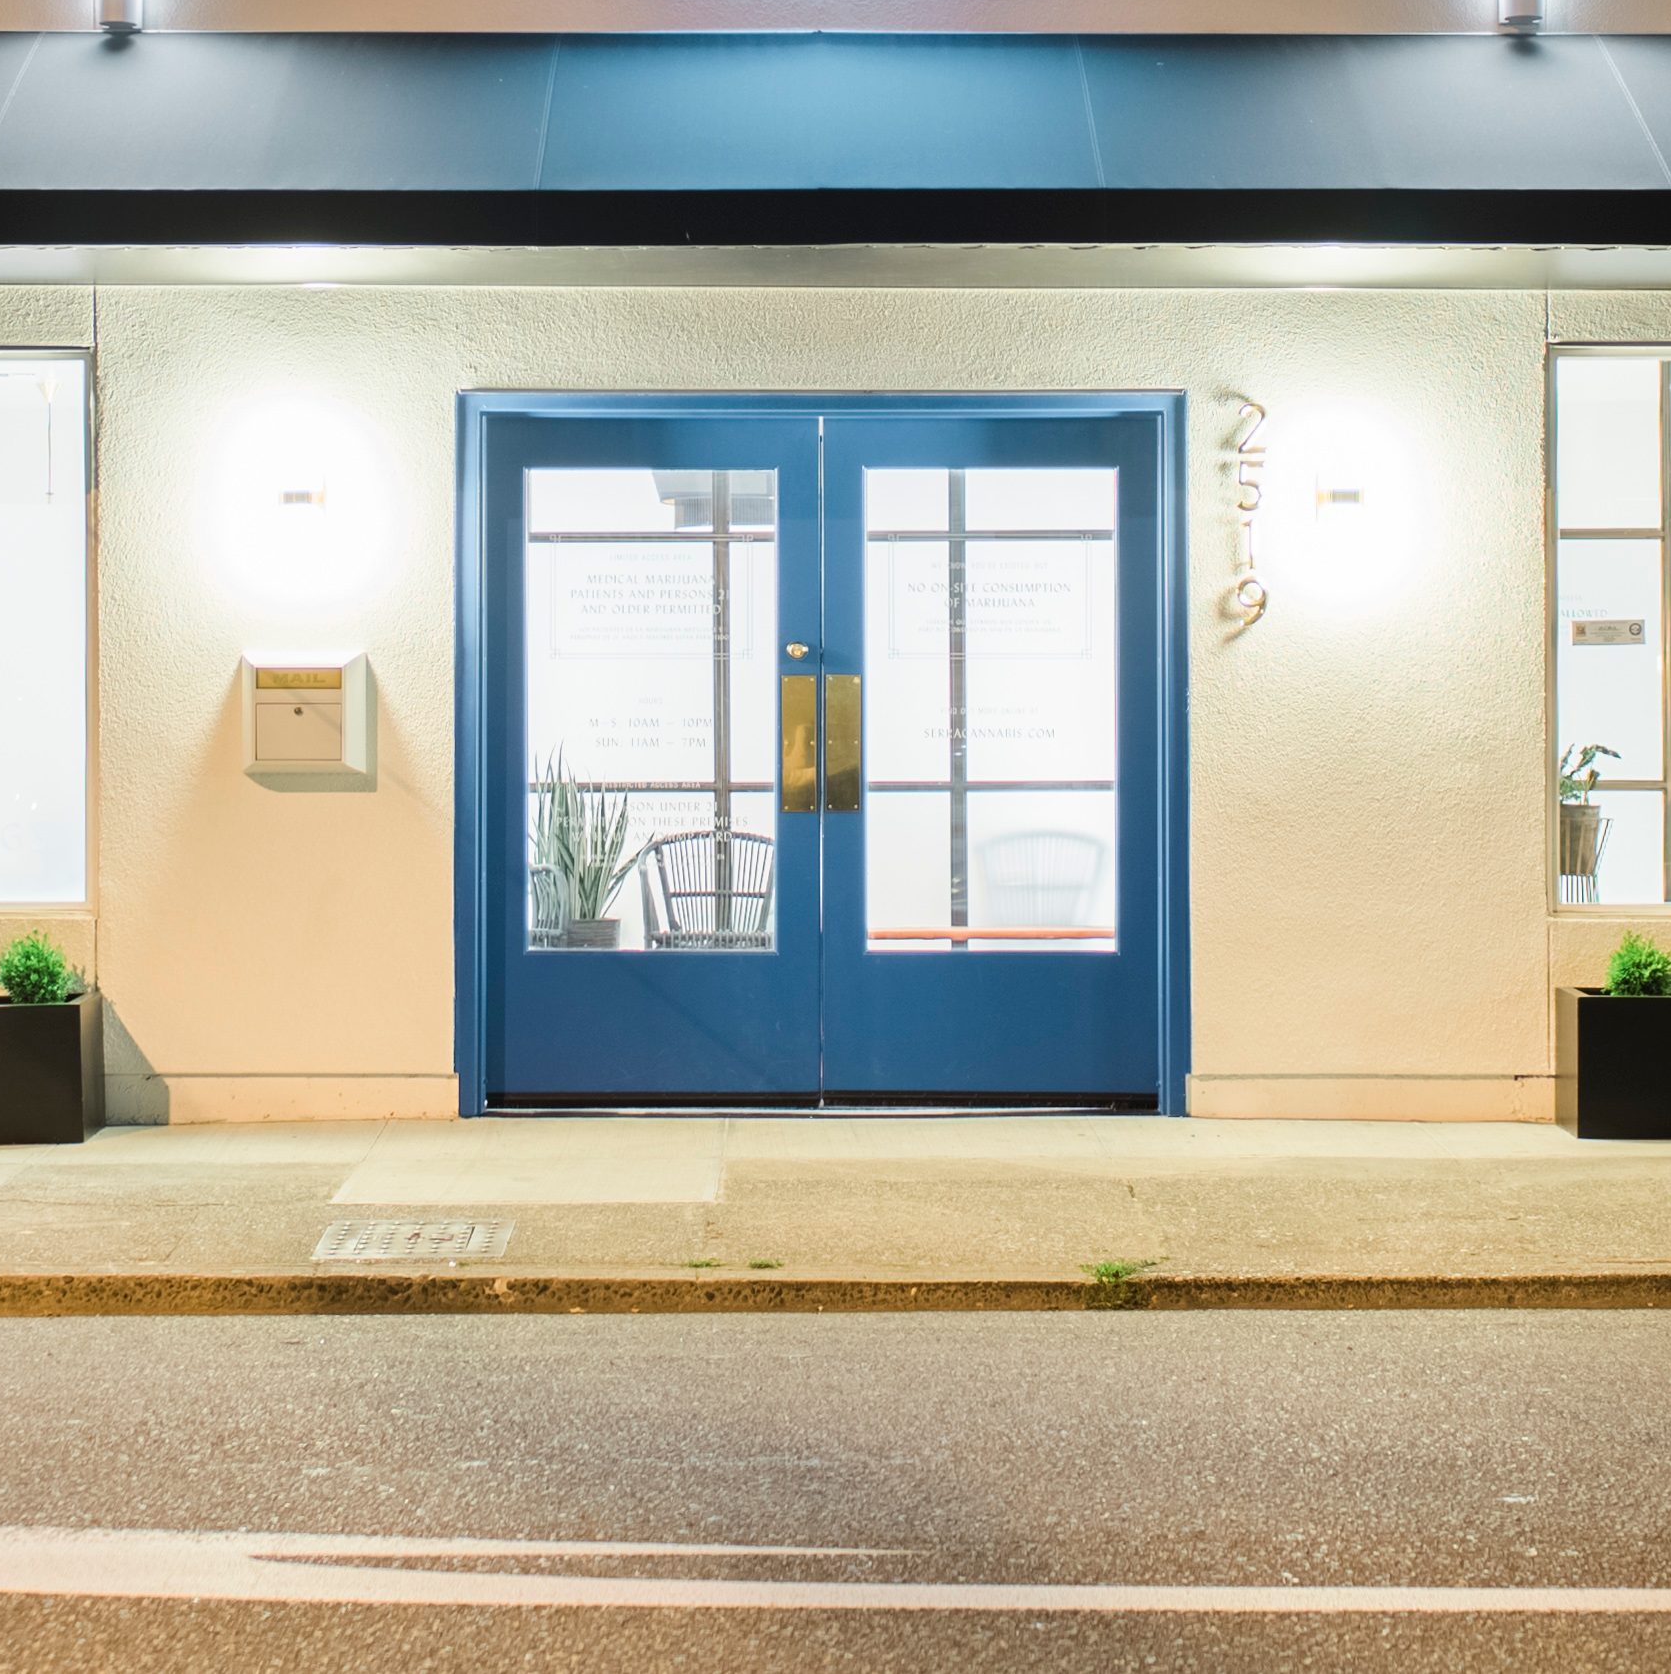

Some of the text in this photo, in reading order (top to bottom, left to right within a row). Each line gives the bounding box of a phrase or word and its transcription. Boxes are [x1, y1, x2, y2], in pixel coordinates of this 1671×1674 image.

[1237, 403, 1266, 626] 2519
[586, 574, 715, 585] MEDICAL MARIJUANA
[907, 582, 926, 593] NO
[983, 582, 1072, 593] CONSUMPTION
[570, 589, 624, 599] PATIENTS
[629, 589, 655, 599] AND
[659, 589, 714, 599] PERSONS
[944, 597, 1036, 608] OF MARIJUANA
[581, 604, 721, 615] AND OLDER PERMITTED
[272, 673, 326, 684] MAIL
[628, 717, 660, 728] 10AM
[682, 717, 713, 728] 10PM
[682, 737, 706, 748] 7PM
[660, 801, 700, 812] UNDER
[653, 816, 685, 827] THESE
